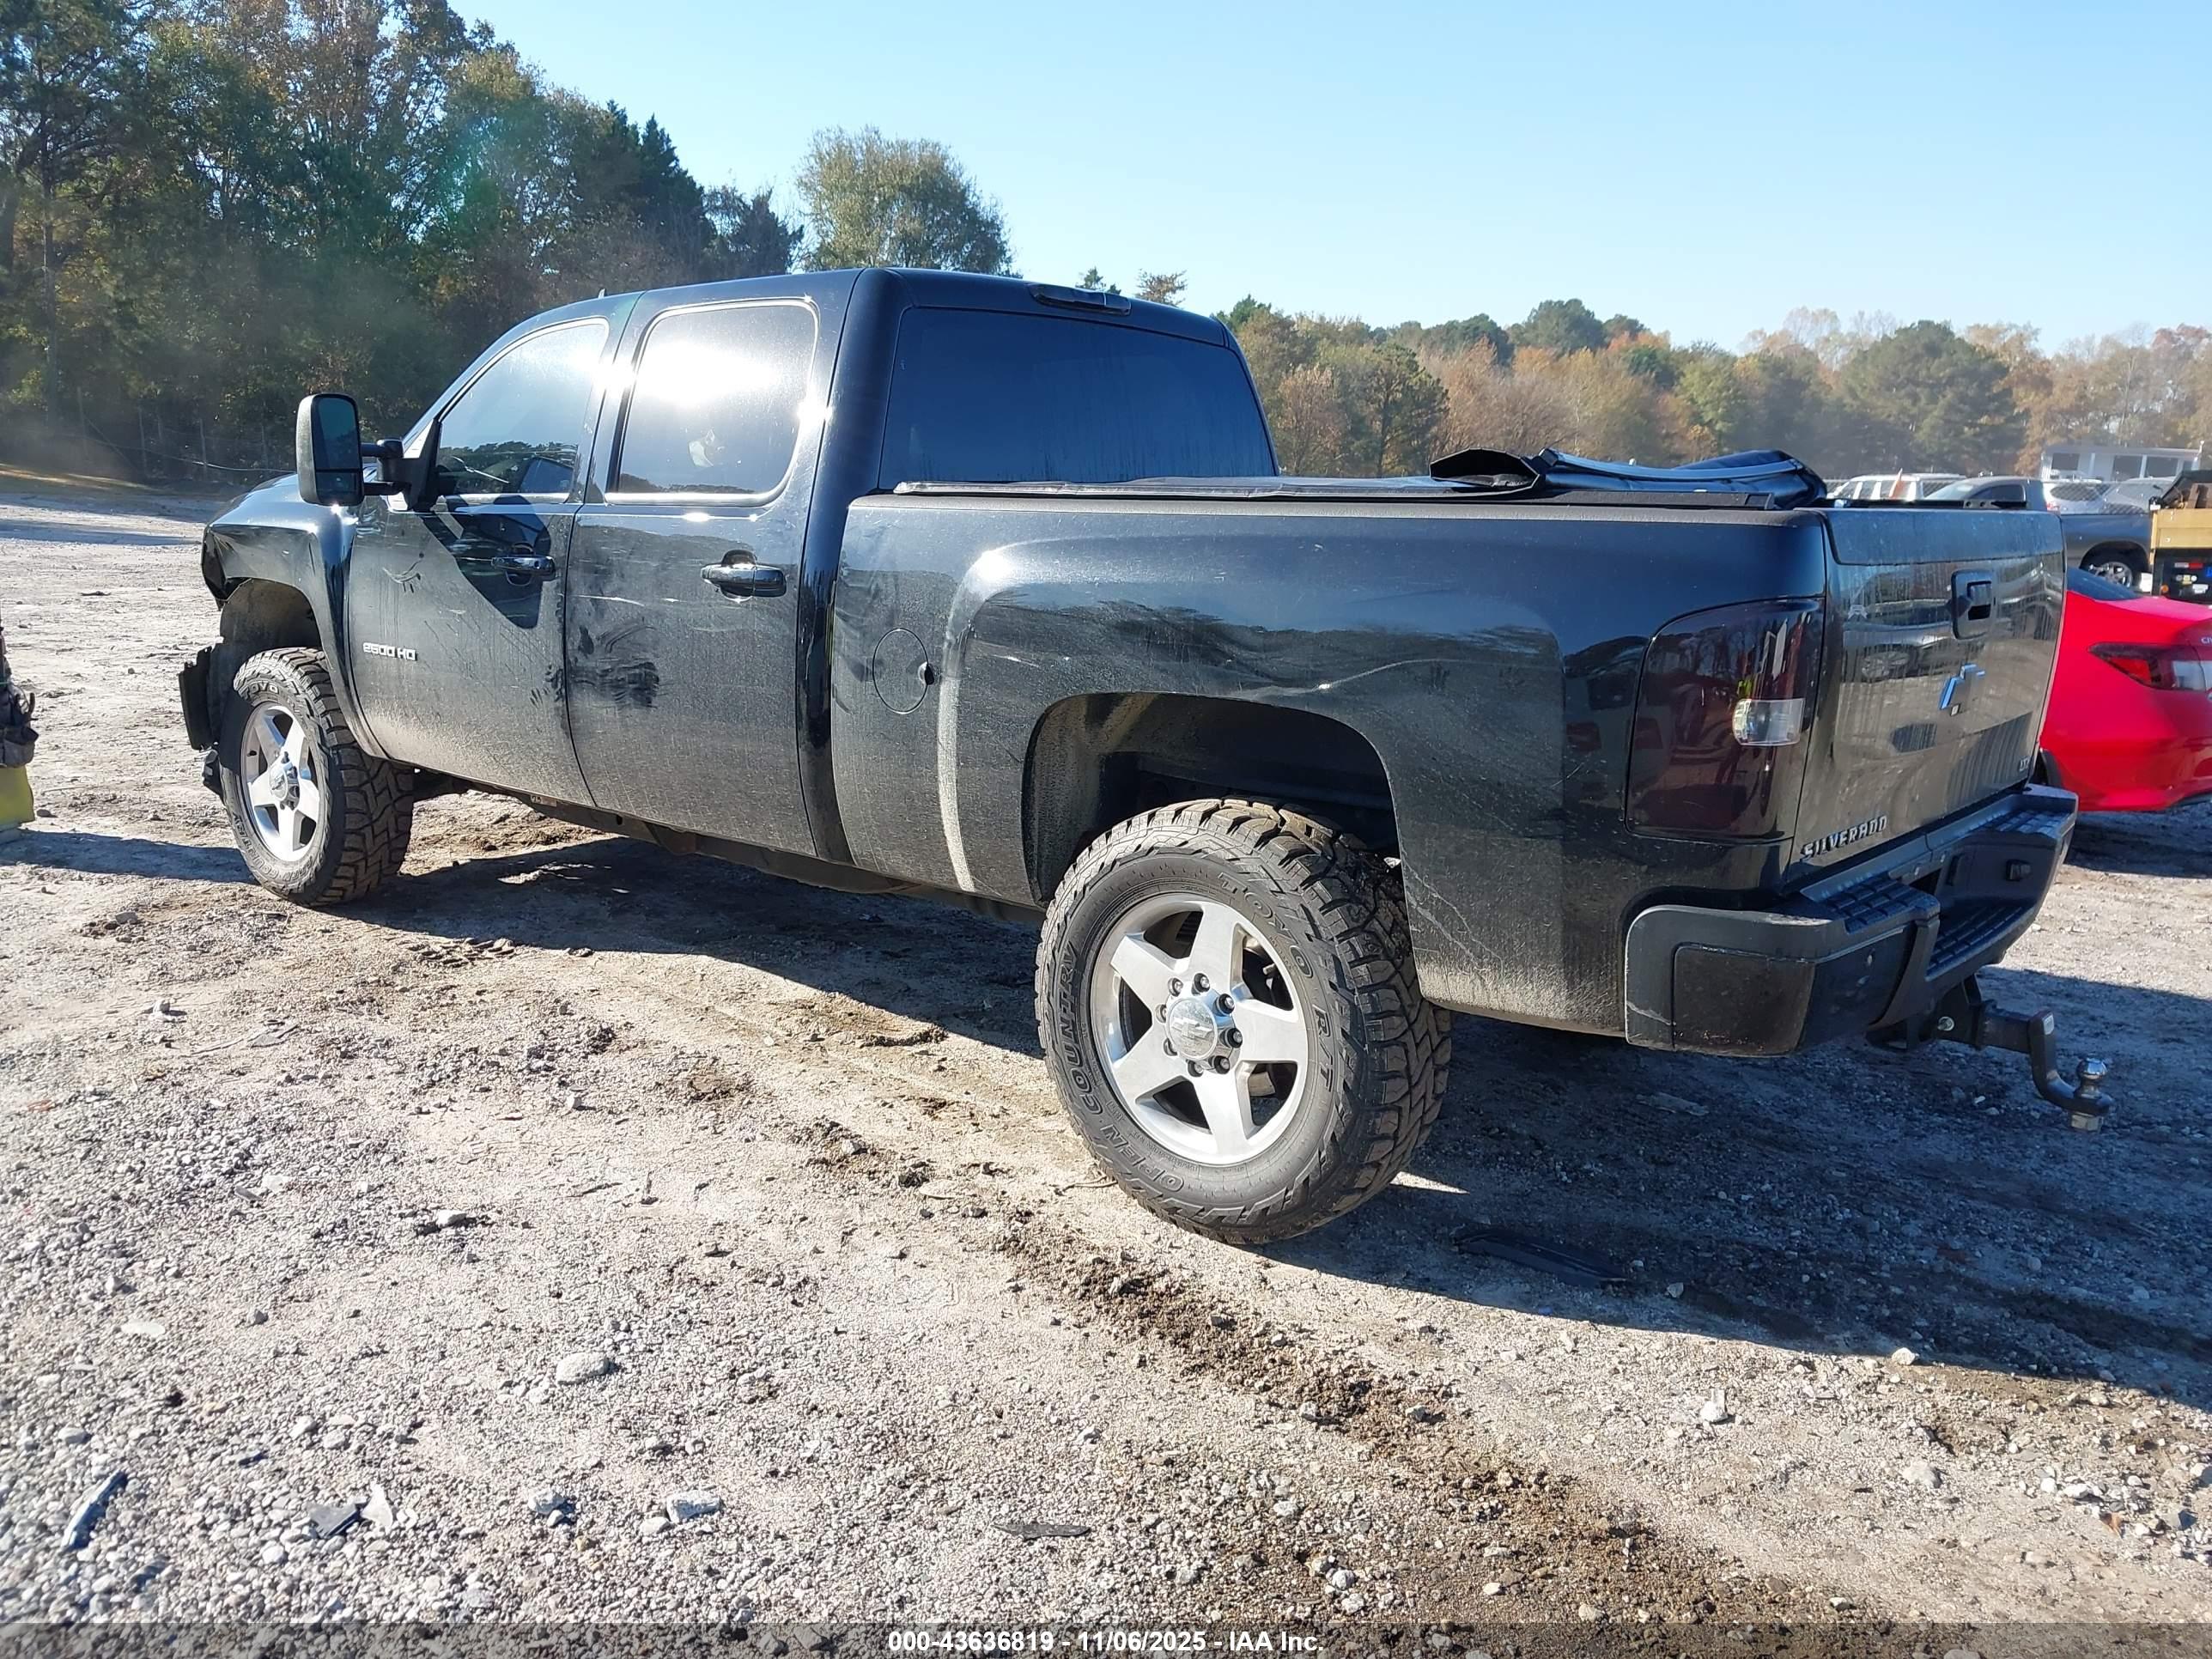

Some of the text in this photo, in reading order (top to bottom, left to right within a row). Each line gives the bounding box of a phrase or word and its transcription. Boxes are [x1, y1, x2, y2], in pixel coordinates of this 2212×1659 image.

[363, 642, 416, 661] 2500 HD
[1801, 815, 1887, 857] SILVERADO
[1217, 872, 1314, 979] TOYO
[1059, 940, 1103, 1115] COUNTRY
[1099, 1124, 1185, 1193] OPEN
